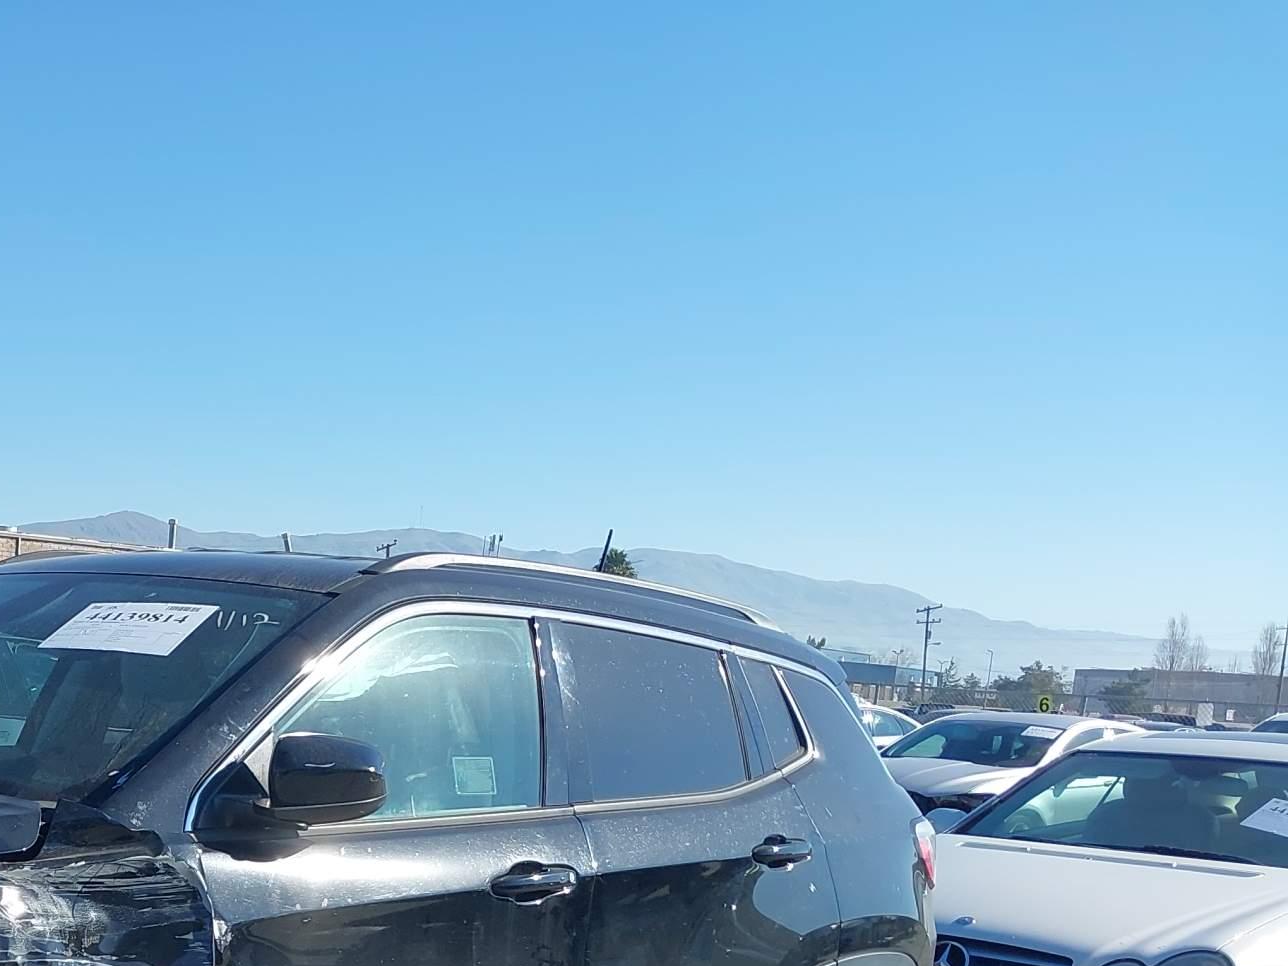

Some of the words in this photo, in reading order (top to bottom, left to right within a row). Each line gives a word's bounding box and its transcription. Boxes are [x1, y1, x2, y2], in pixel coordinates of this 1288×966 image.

[86, 612, 189, 624] 44139814
[217, 610, 280, 631] 1/12
[1039, 697, 1049, 712] 6
